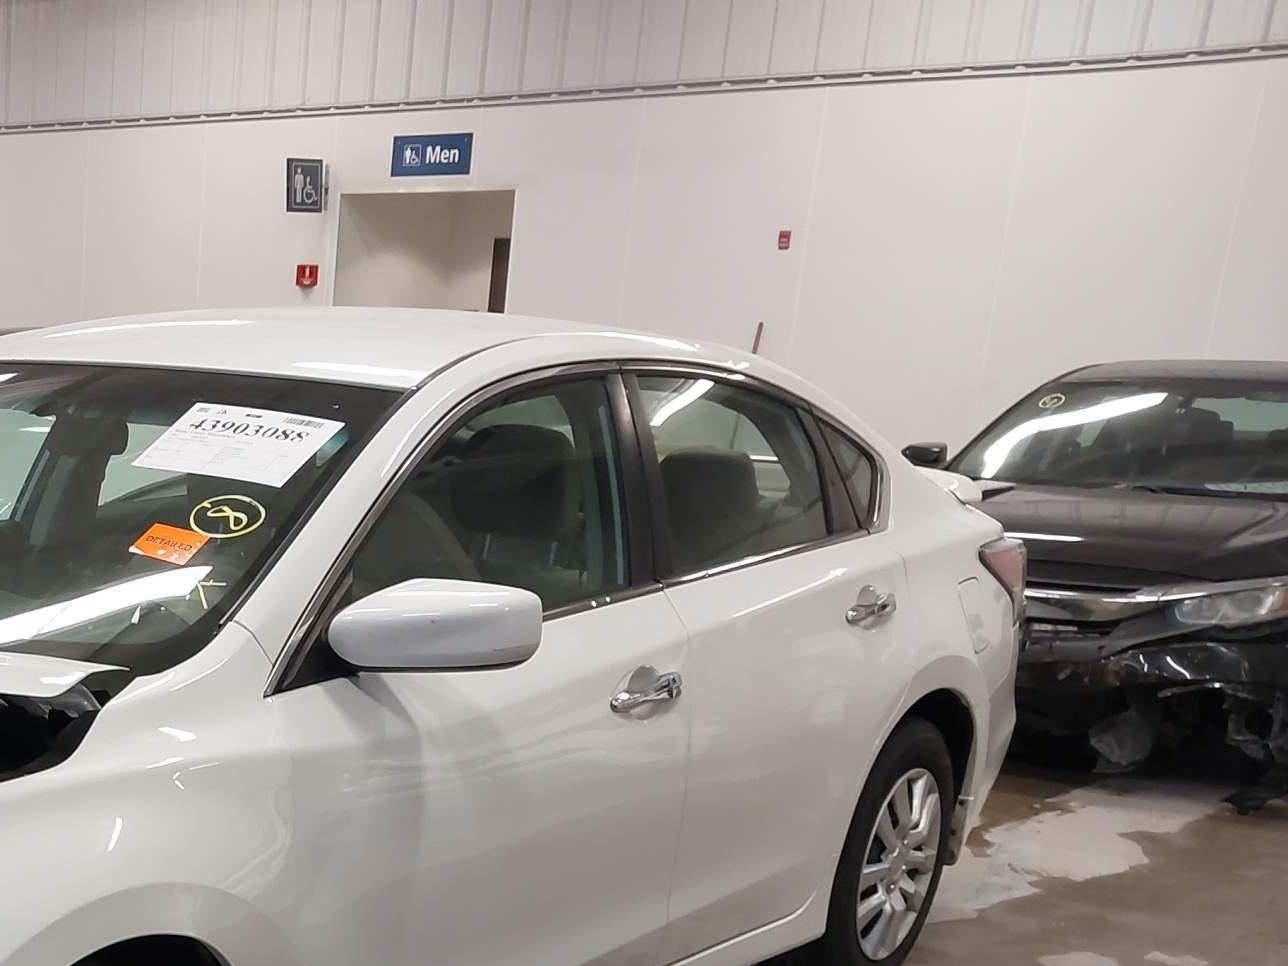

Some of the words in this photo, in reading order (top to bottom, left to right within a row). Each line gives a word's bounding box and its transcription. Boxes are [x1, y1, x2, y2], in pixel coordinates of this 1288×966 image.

[425, 145, 460, 164] Men
[189, 418, 310, 442] 43903088
[145, 535, 193, 551] DETAILED
